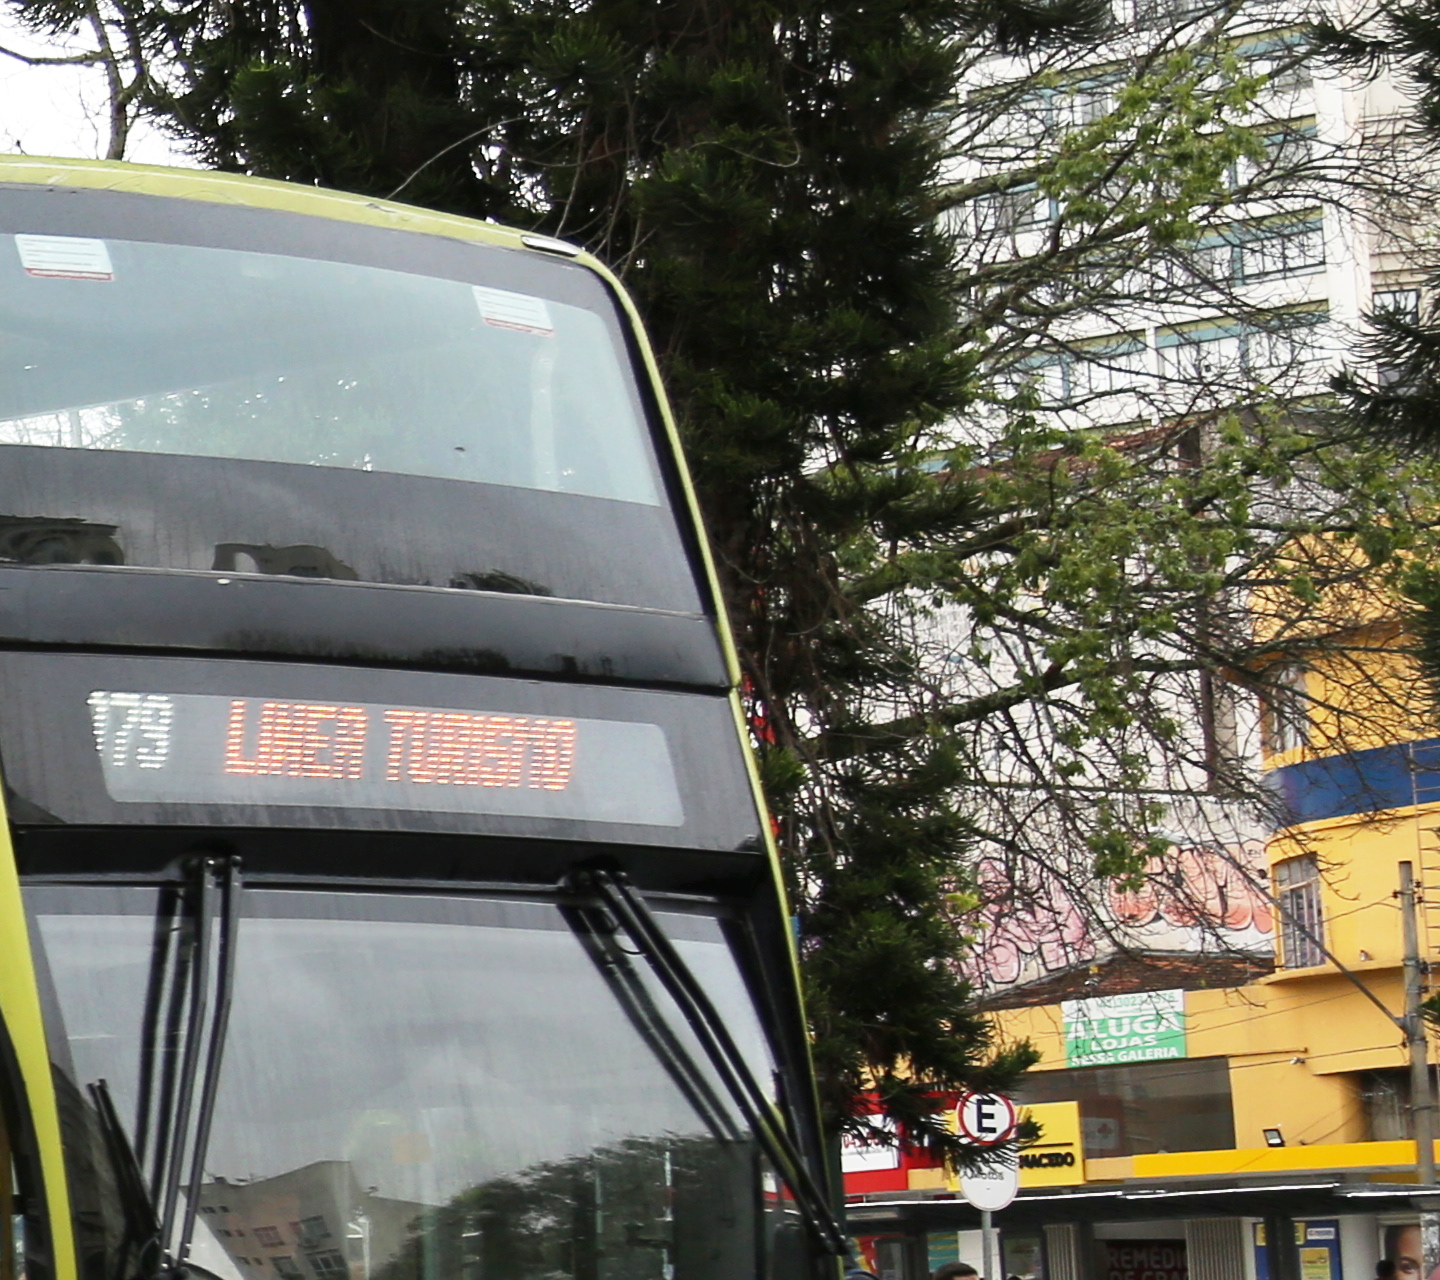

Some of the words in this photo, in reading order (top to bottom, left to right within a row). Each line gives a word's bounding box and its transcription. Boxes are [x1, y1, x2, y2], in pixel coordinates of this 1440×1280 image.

[225, 699, 368, 780] LINEA
[383, 709, 576, 791] TURISMO
[1066, 1012, 1183, 1040] ALUGA
[1091, 1035, 1158, 1051] LOJAS
[1117, 1047, 1179, 1061] GALERIA
[977, 1098, 997, 1134] E
